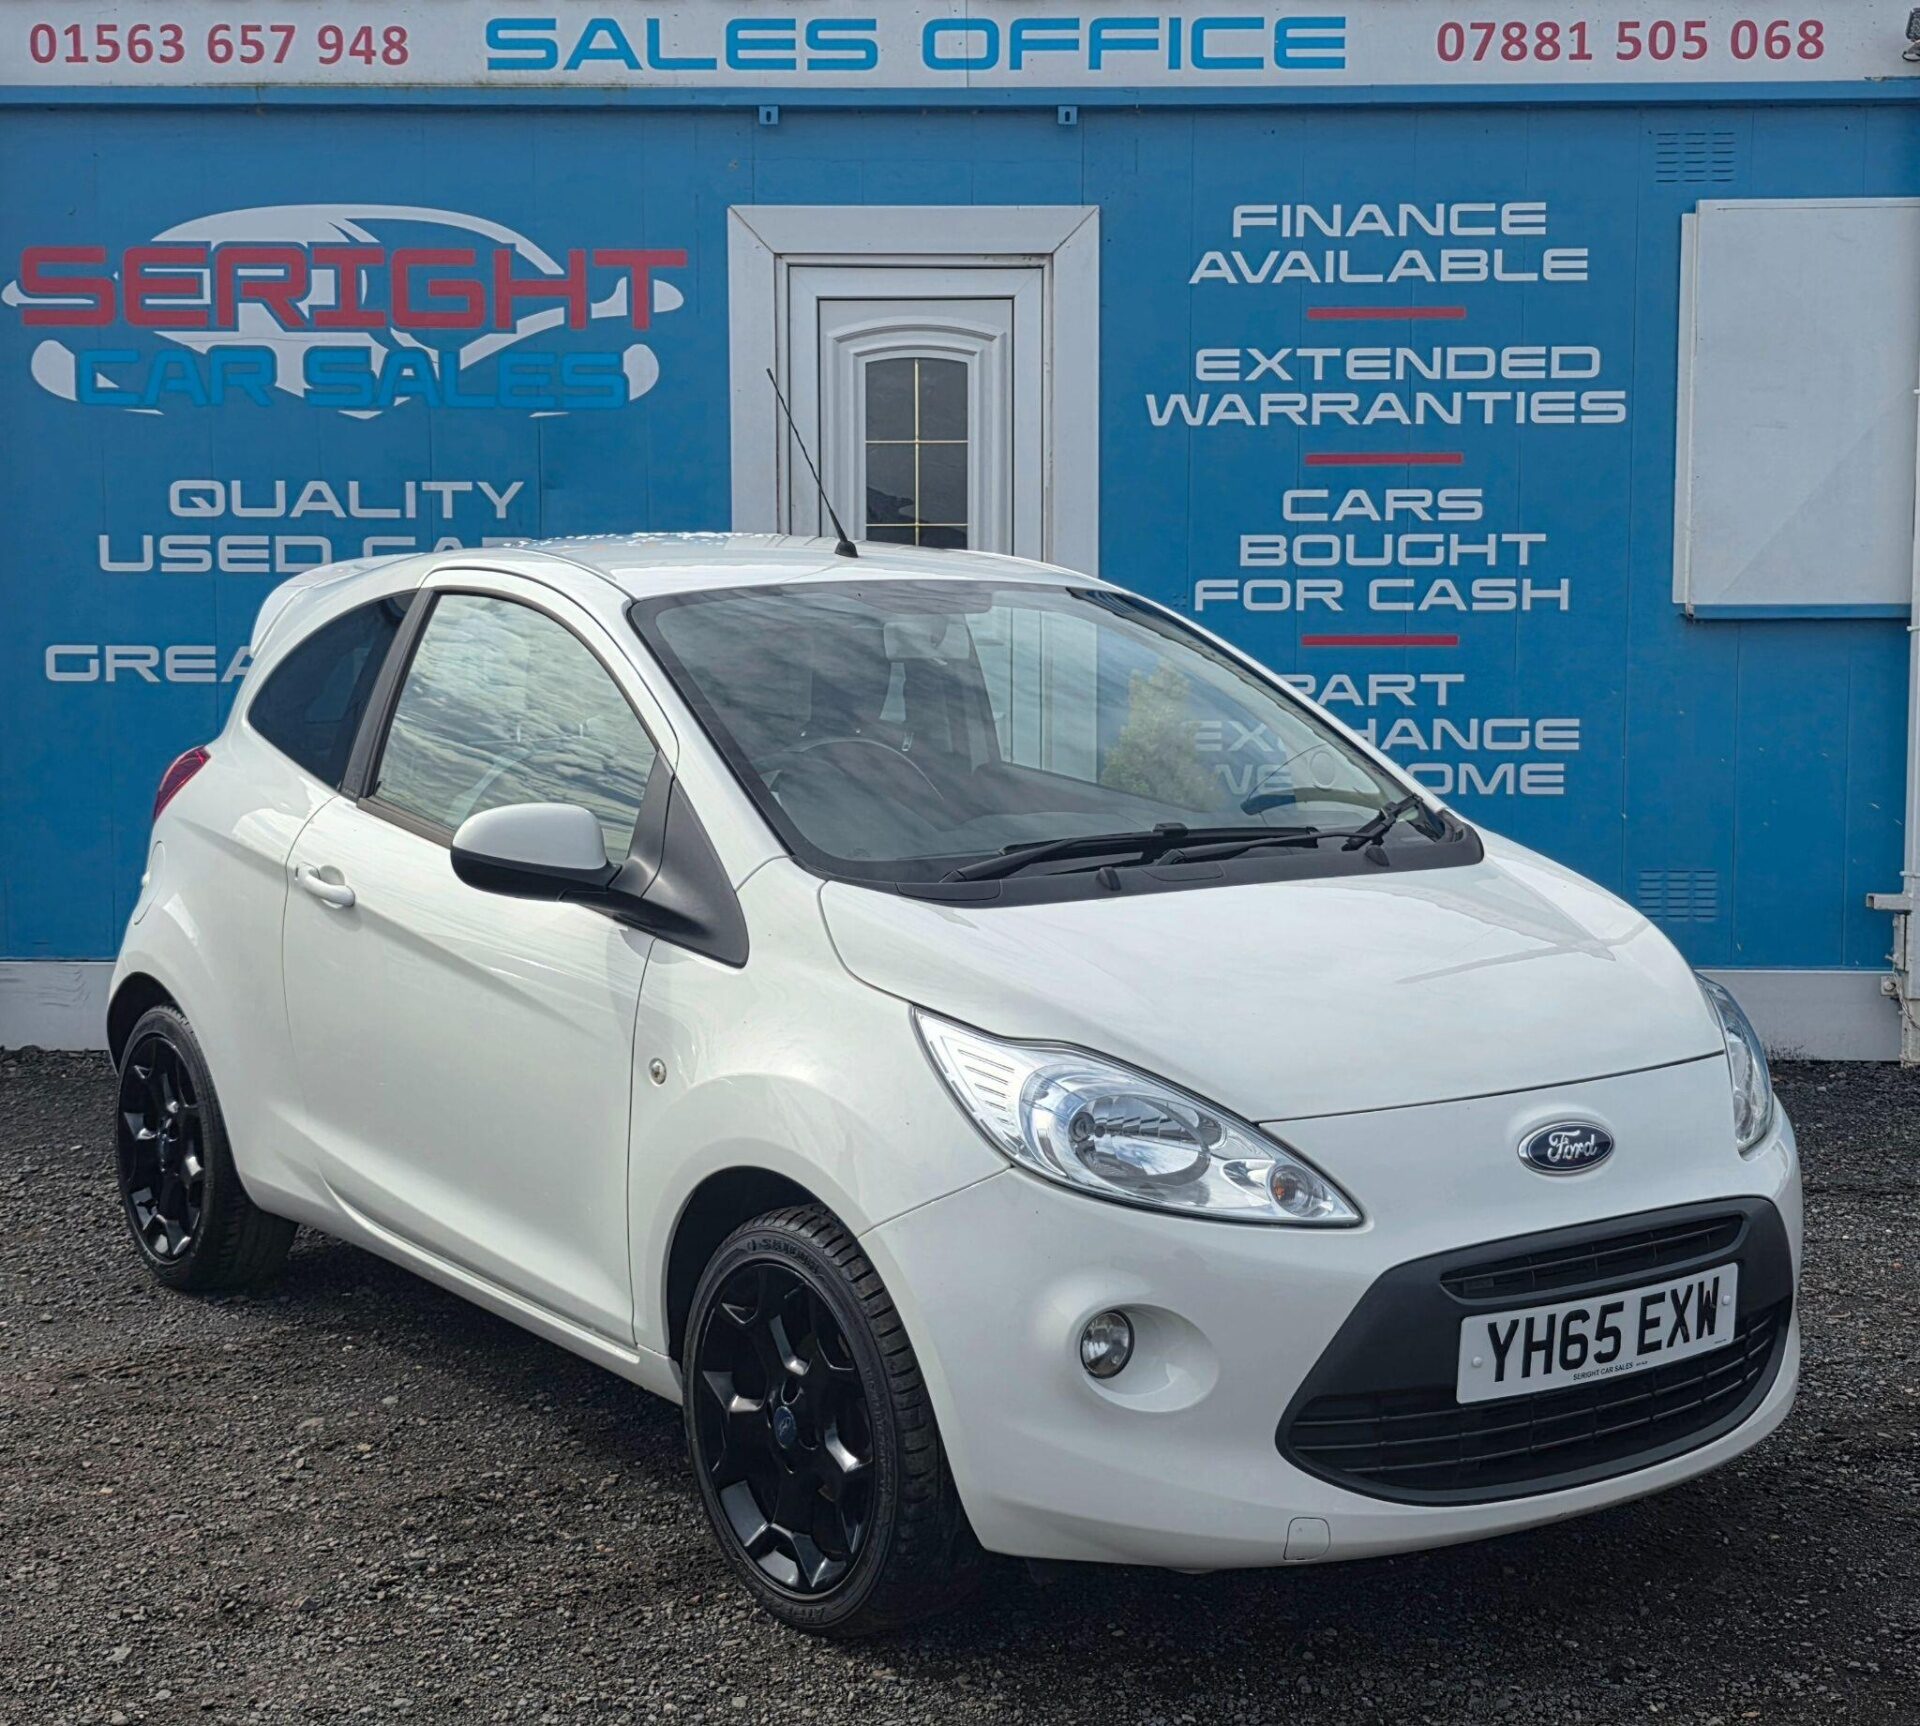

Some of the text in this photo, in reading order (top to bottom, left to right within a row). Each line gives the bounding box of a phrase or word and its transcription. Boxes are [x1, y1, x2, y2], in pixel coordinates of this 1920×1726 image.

[29, 23, 410, 66] 01563 657 948
[485, 16, 1346, 72] SALES OFFICE
[1436, 19, 1826, 62] 07881 505 068
[1232, 202, 1547, 239] FINANCE
[1188, 247, 1589, 285] AVAILABLE
[20, 246, 687, 331] SERIGHT
[76, 347, 628, 411] CAR SALES
[1194, 346, 1601, 383] EXTENDED
[1145, 390, 1627, 428] WARRANTIES
[169, 480, 524, 519] QUALITY
[1282, 488, 1484, 522] CARS
[99, 534, 332, 573] USED
[1239, 533, 1547, 568] BOUGHT
[1194, 578, 1570, 612] FOR CASH
[45, 644, 251, 683] GREA
[1547, 1130, 1598, 1163] Ford
[1487, 1276, 1720, 1383] YH65 EXW
[1573, 1369, 1600, 1381] SERIGHT
[1600, 1366, 1614, 1376] CAR
[1614, 1361, 1634, 1373] SALES
